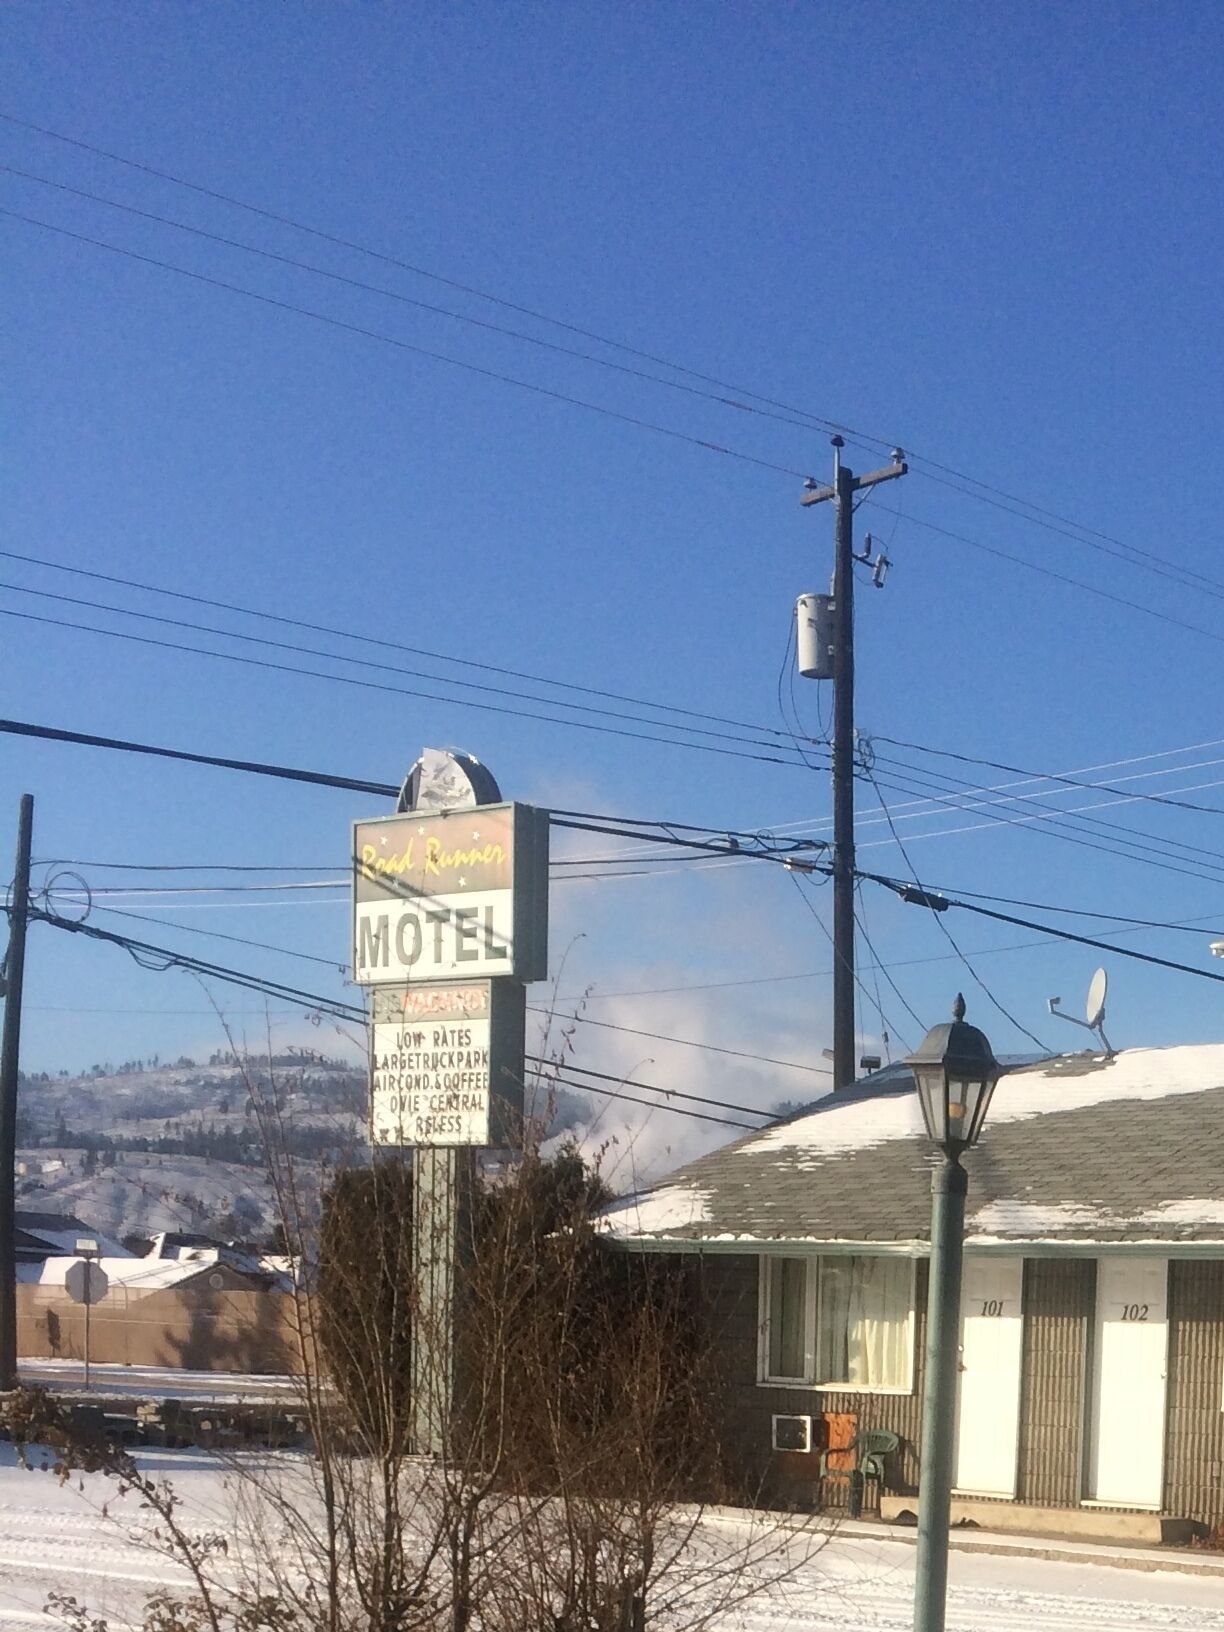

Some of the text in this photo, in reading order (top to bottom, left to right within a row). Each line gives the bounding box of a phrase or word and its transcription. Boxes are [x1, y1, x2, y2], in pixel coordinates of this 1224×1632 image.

[362, 837, 506, 880] Road Runner
[359, 905, 507, 968] MOTEL
[396, 1028, 472, 1049] LOW RATES
[981, 1300, 1004, 1317] 101
[1120, 1304, 1149, 1321] 102
